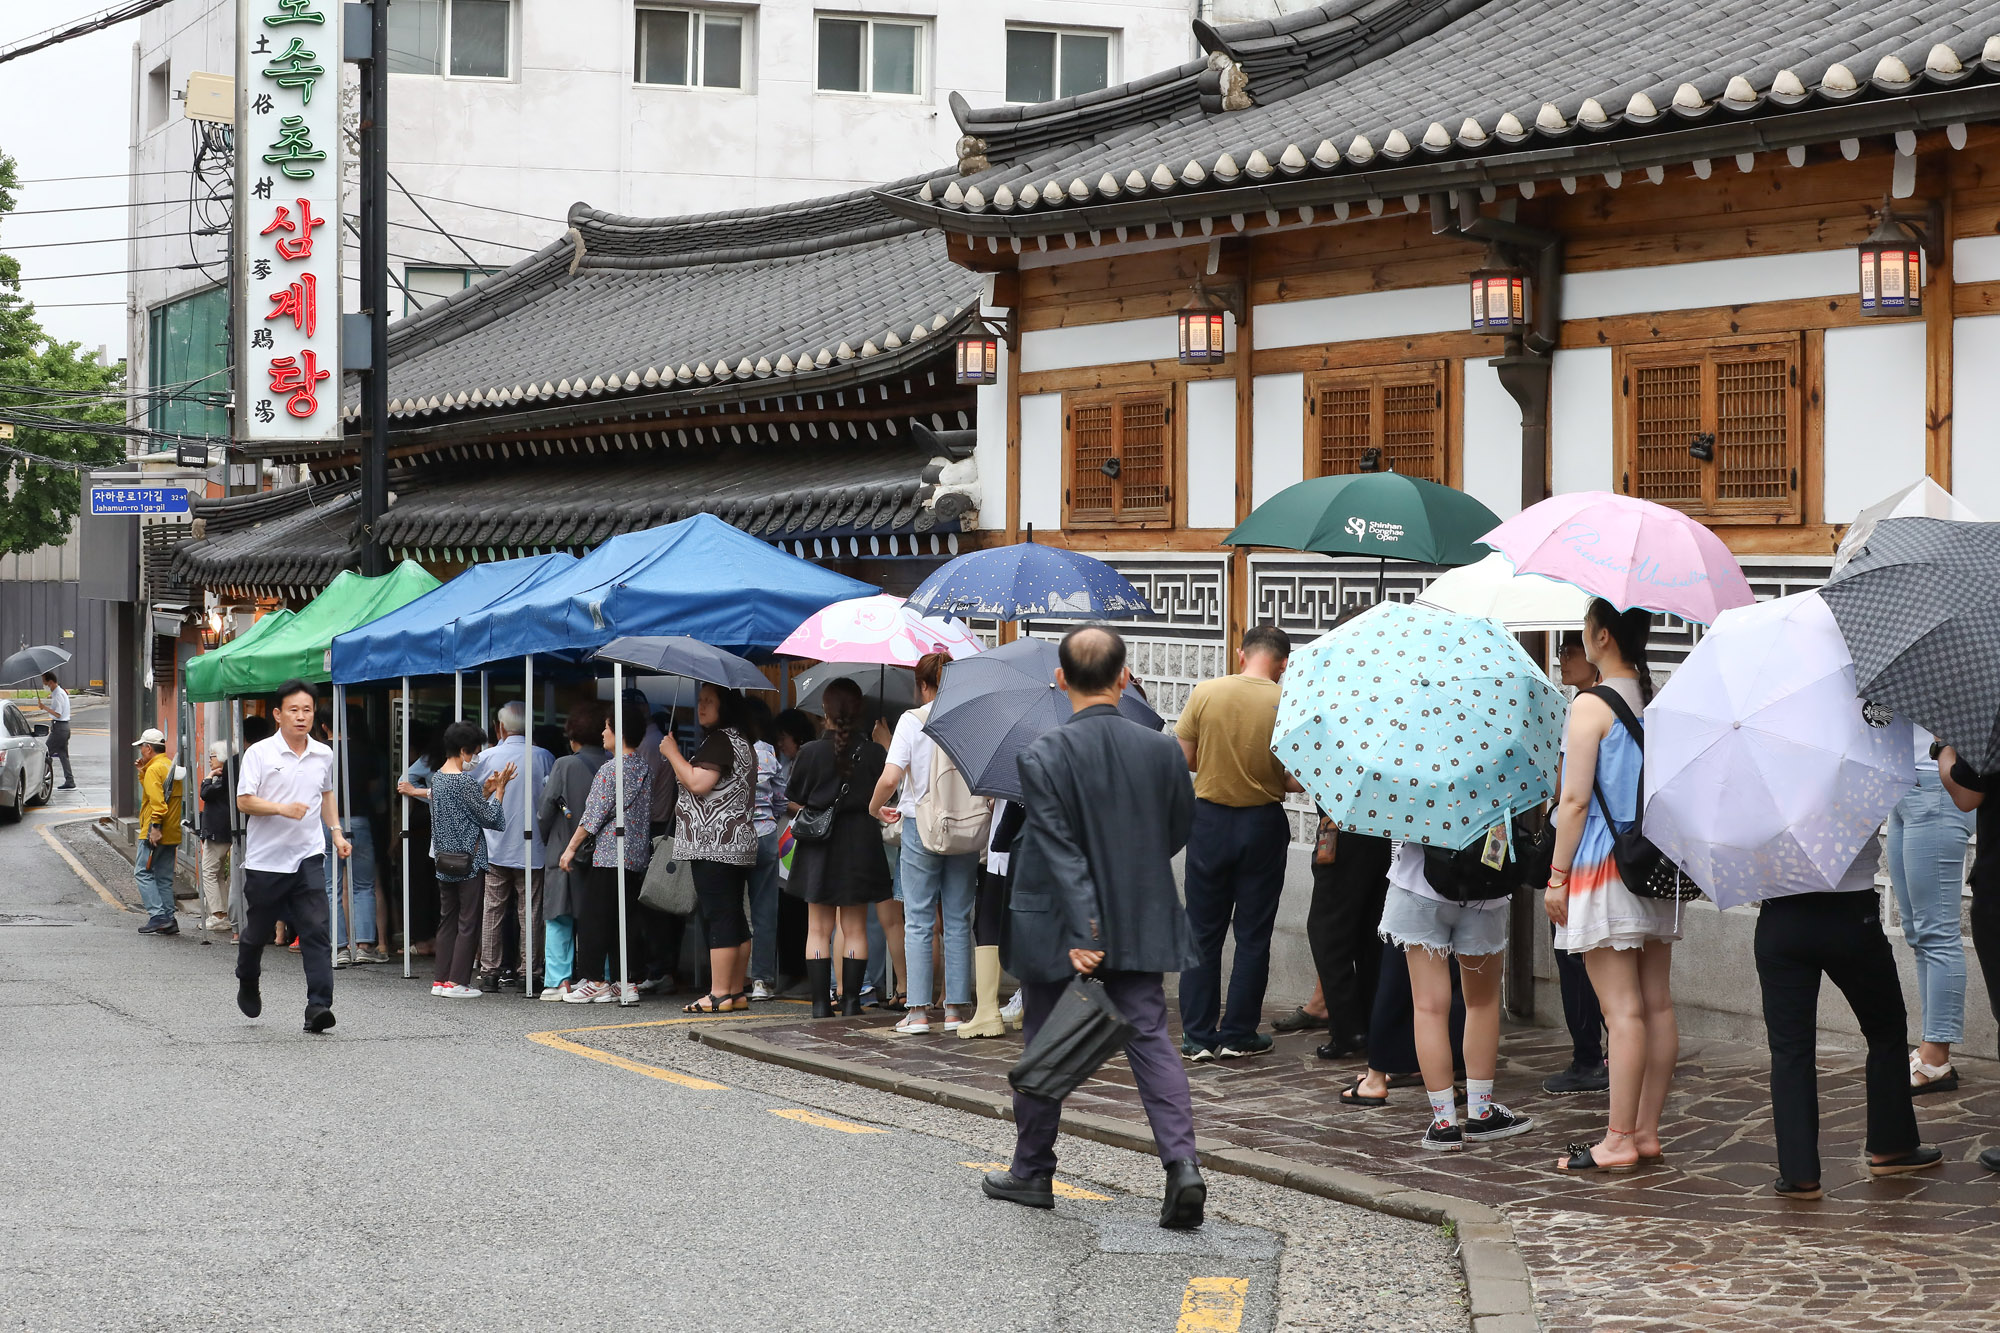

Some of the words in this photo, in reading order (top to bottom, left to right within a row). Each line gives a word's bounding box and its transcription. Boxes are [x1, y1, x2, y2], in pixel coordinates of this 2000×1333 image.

[260, 198, 331, 418] 삼계탕
[95, 490, 163, 503] 자하문로1가길
[95, 504, 139, 512] Jahamun-ro
[140, 503, 166, 513] 1ga-gil
[1368, 525, 1405, 537] Donghae
[1369, 521, 1403, 530] Shinhan
[1376, 533, 1399, 542] Open
